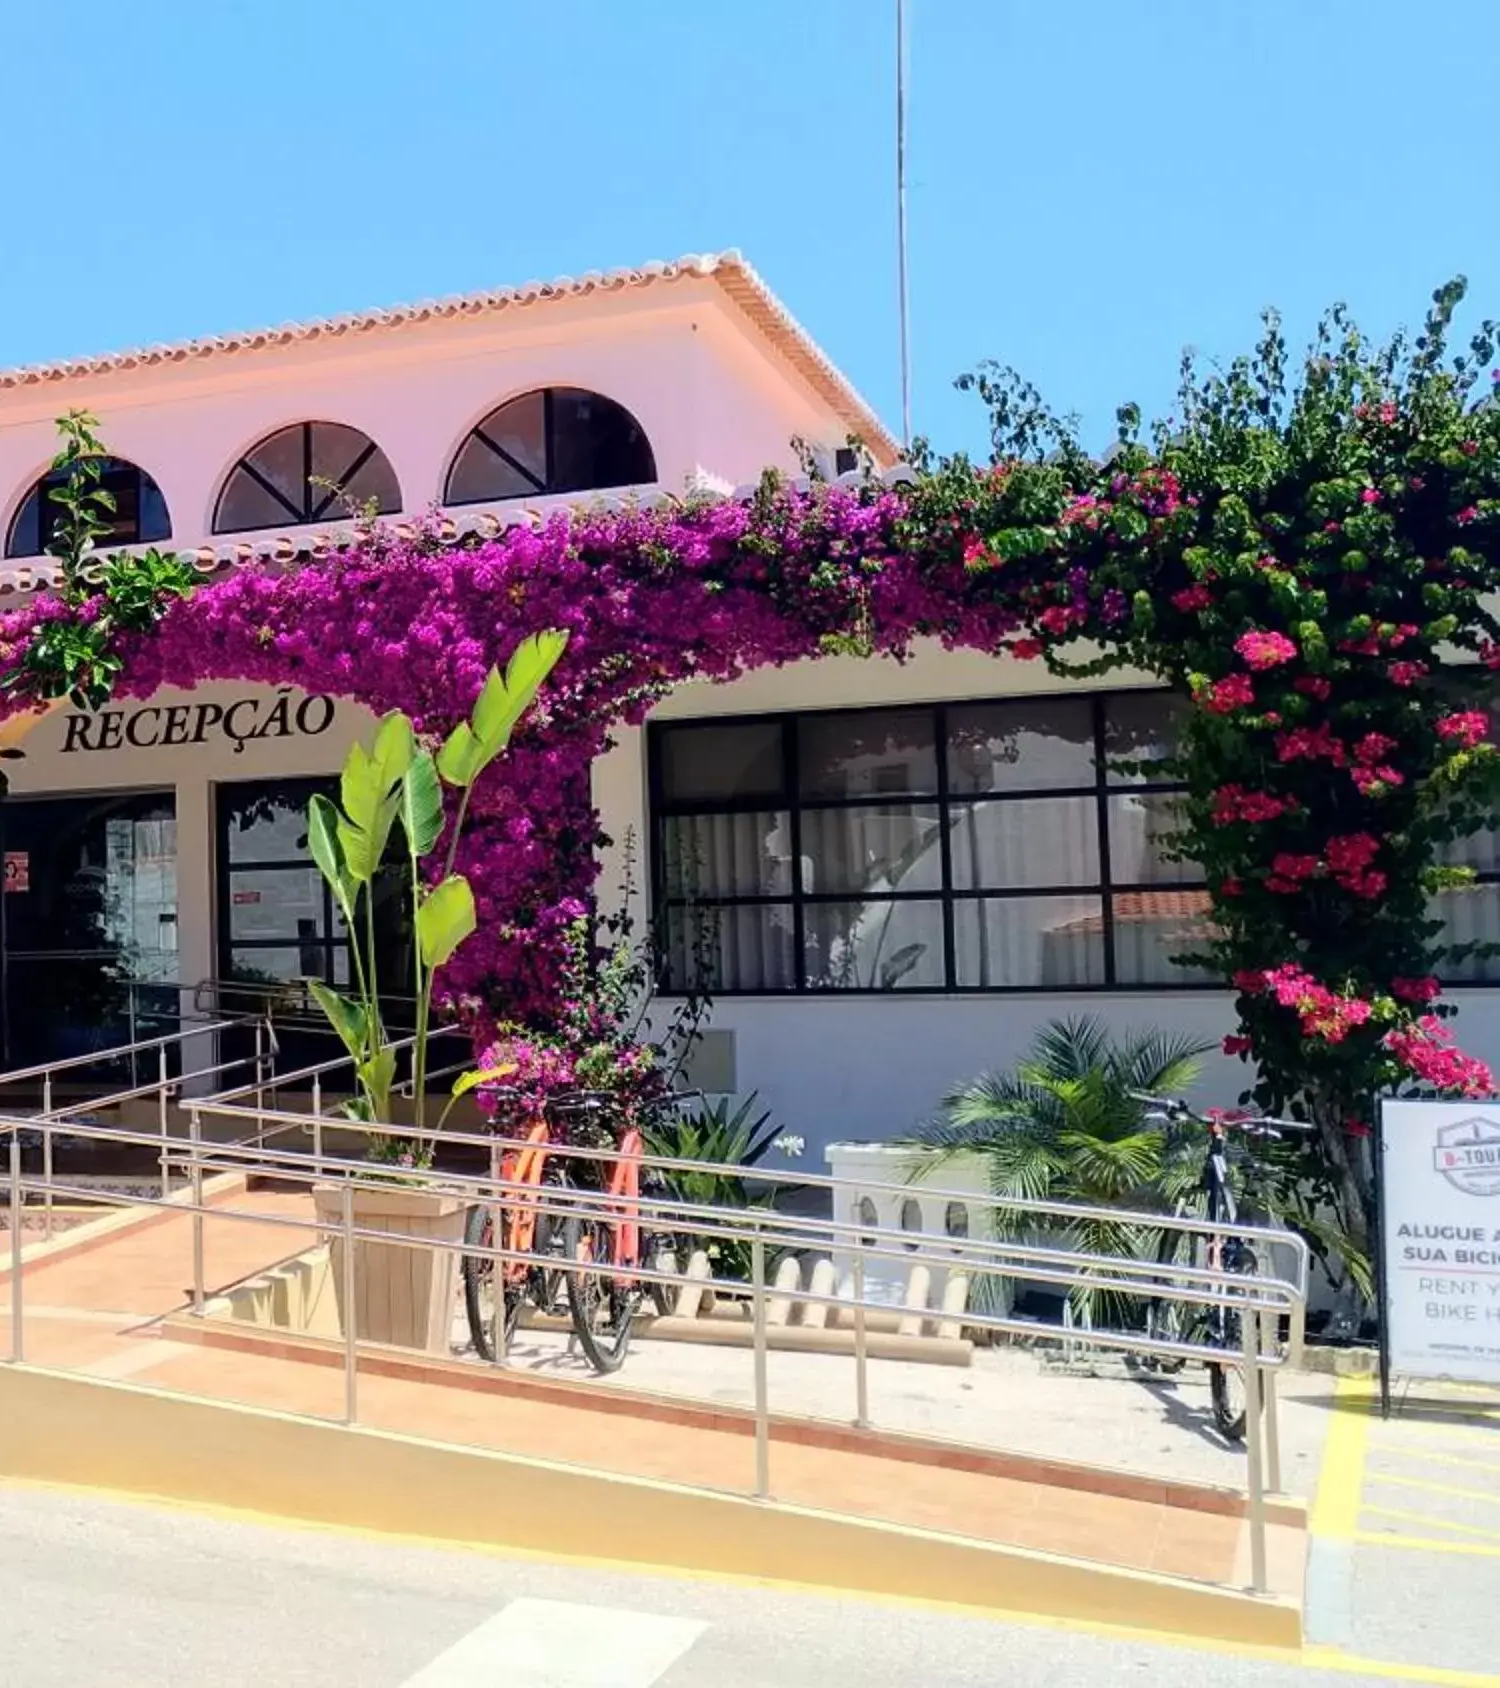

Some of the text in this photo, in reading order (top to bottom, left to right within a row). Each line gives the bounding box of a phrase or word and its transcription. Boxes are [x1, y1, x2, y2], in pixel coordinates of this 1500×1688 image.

[59, 687, 336, 753] RECEPÇÃO
[1396, 1223, 1485, 1242] ALUGUE
[1402, 1246, 1447, 1262] SUA
[1419, 1277, 1479, 1295] RENT
[1425, 1301, 1477, 1321] BIKE
